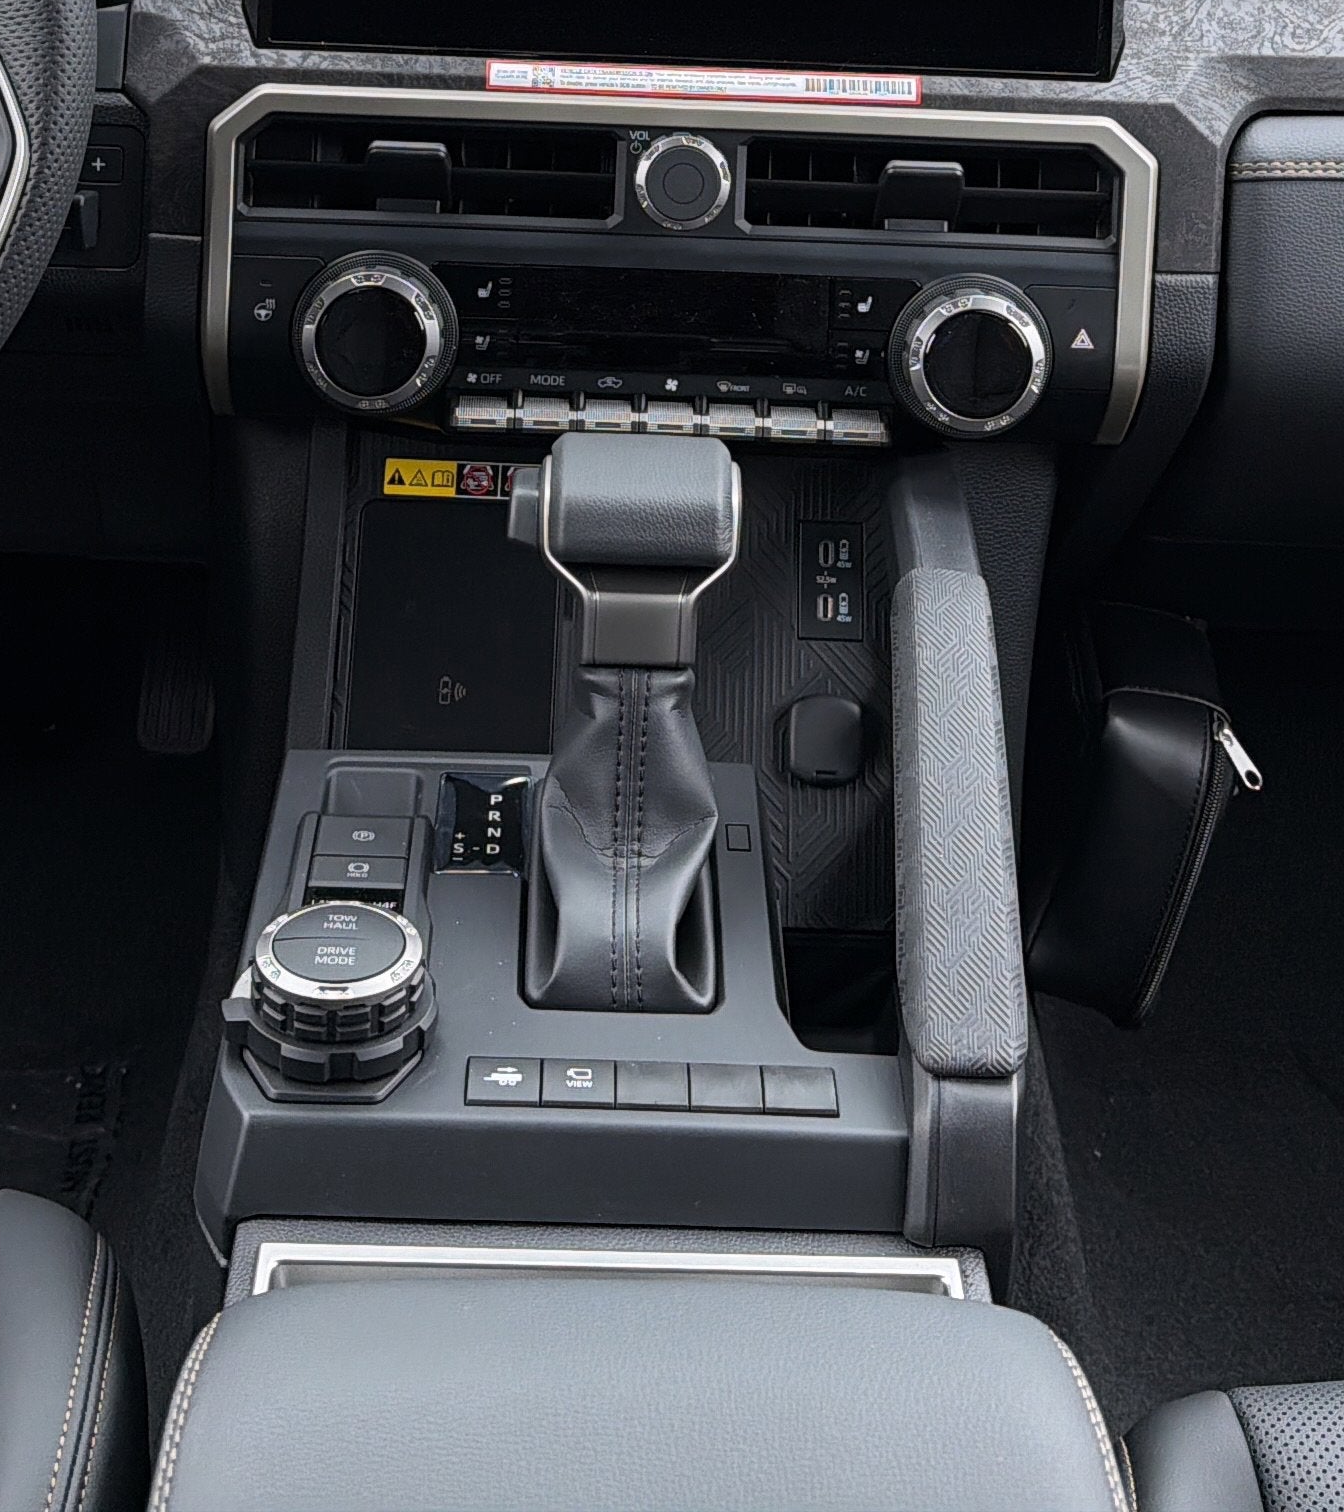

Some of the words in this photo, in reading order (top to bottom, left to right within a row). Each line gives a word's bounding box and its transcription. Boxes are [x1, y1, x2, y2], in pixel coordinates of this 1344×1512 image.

[629, 130, 650, 141] VOL
[480, 373, 502, 384] OFF
[530, 374, 565, 386] MODE
[729, 384, 750, 392] FRONT
[844, 385, 867, 397] A/C
[490, 794, 503, 805] P
[488, 810, 501, 821] R
[487, 827, 501, 838] N
[453, 842, 464, 853] S
[486, 843, 500, 854] D
[323, 922, 358, 930] HAUL
[317, 946, 357, 956] DRIVE
[314, 956, 356, 966] MODE
[566, 1080, 593, 1088] VIEW
